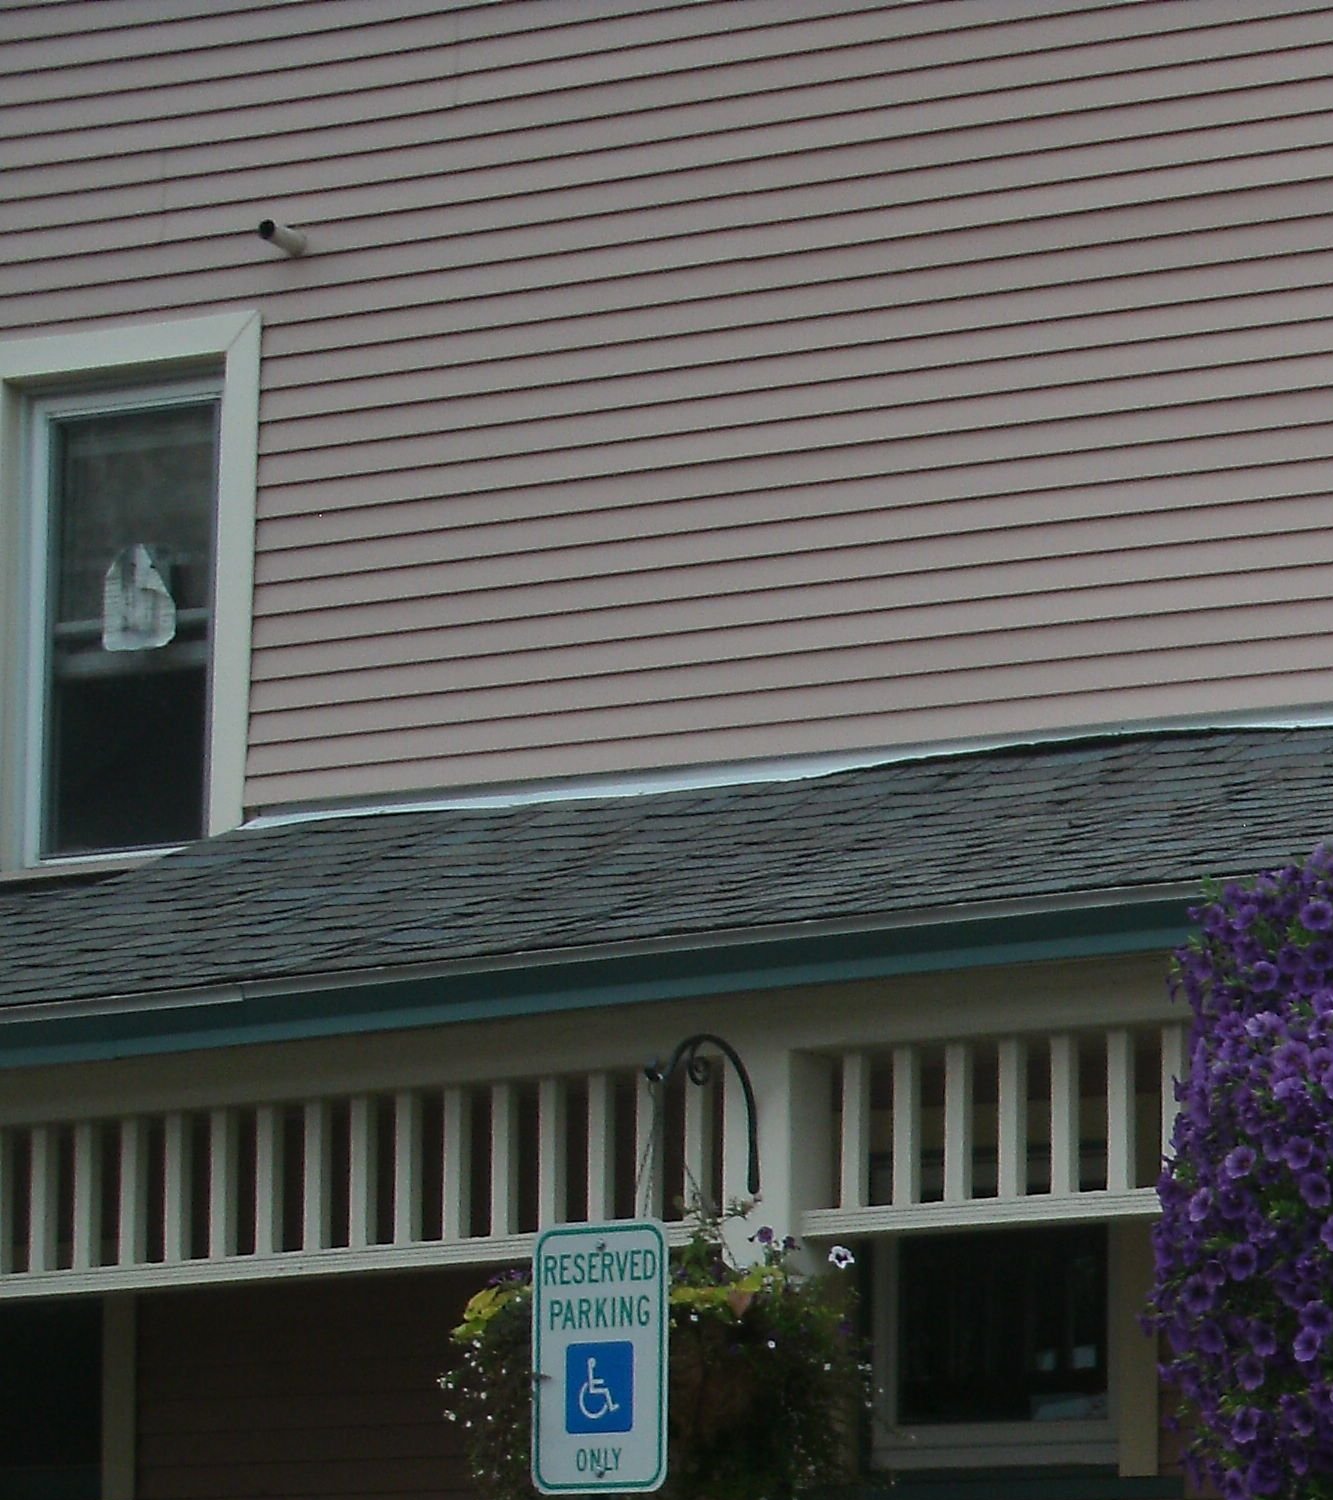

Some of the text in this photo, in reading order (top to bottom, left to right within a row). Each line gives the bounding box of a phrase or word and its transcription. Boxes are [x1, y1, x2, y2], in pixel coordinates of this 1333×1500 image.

[543, 1249, 656, 1286] RESERVED
[550, 1295, 651, 1331] PARKING
[576, 1447, 622, 1473] ONLY
